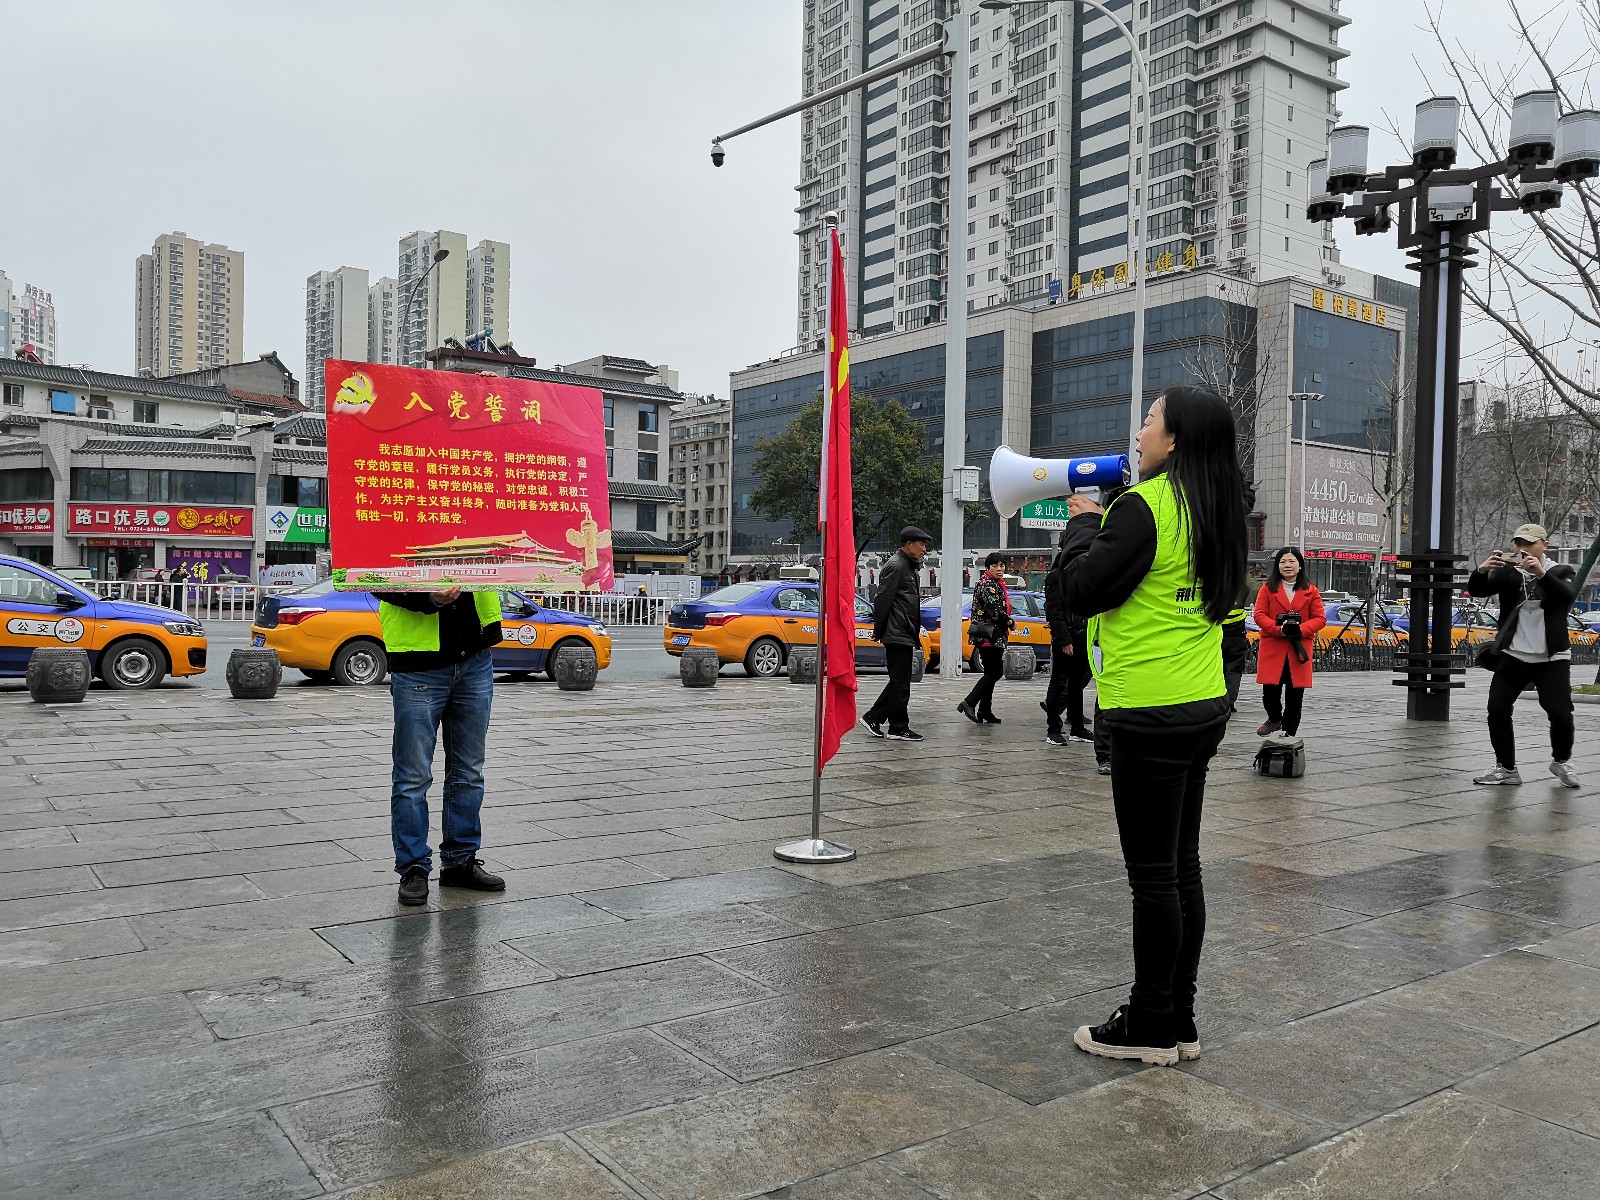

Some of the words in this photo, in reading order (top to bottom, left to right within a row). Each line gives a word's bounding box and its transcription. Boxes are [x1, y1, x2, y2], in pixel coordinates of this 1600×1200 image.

[404, 391, 542, 425] 入党誓词
[75, 508, 150, 526] 路口优易
[355, 509, 467, 524] 牺牲一切，永不叛党。
[17, 622, 49, 633] 公交
